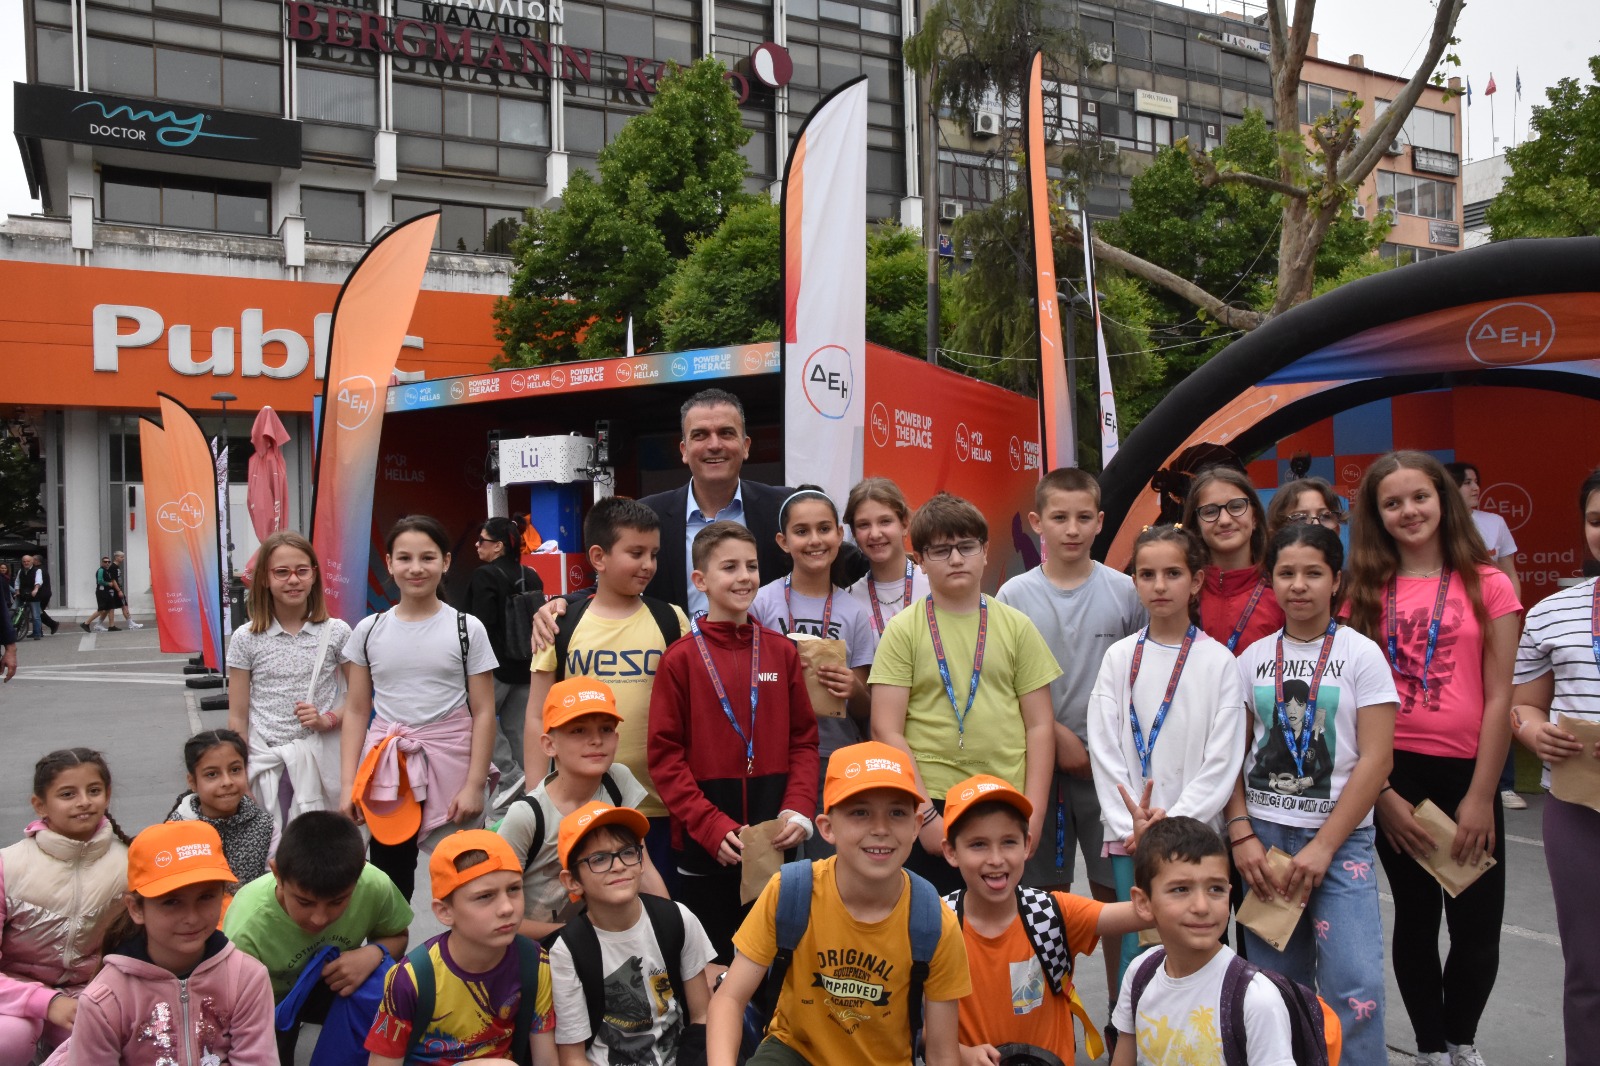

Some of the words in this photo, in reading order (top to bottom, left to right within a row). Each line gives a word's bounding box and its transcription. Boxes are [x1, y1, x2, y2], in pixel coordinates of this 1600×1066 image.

[288, 1, 592, 85] BERGMANN
[90, 124, 146, 140] DOCTOR
[93, 304, 425, 382] Publc
[1475, 323, 1541, 348] ΔΕΗ
[694, 355, 720, 364] POWER
[721, 354, 731, 362] UP
[708, 361, 731, 371] RACE
[570, 368, 594, 376] POWER
[583, 373, 604, 382] RACE
[634, 370, 659, 379] HELLAS
[468, 379, 491, 388] POWER
[491, 378, 500, 386] UP
[480, 384, 500, 394] RACE
[527, 379, 551, 389] HELLAS
[810, 364, 848, 400] ΔΕΗ
[337, 388, 369, 415] ΔΕΗ
[419, 393, 441, 402] HELLAS
[873, 413, 888, 436] ΔΕΗ
[895, 409, 922, 428] POWER
[922, 416, 933, 430] UP
[896, 425, 910, 440] THE
[909, 428, 933, 450] RACE
[521, 447, 539, 469] Lü
[971, 447, 992, 463] HELLAS
[385, 468, 425, 482] HELLAS
[1343, 469, 1360, 478] ΔΕΗ
[1484, 497, 1524, 518] ΔΕΗ
[1533, 549, 1575, 564] and
[757, 672, 779, 682] NIKE
[1256, 659, 1346, 680] WEDNESAY
[865, 758, 891, 767] POWER
[881, 765, 902, 774] RACE
[176, 844, 202, 853] POWER
[817, 948, 894, 982] ORIGINAL
[833, 966, 872, 982] EQUIPMENT
[823, 978, 878, 999] IMPROVED
[830, 996, 865, 1008] ACADEMY
